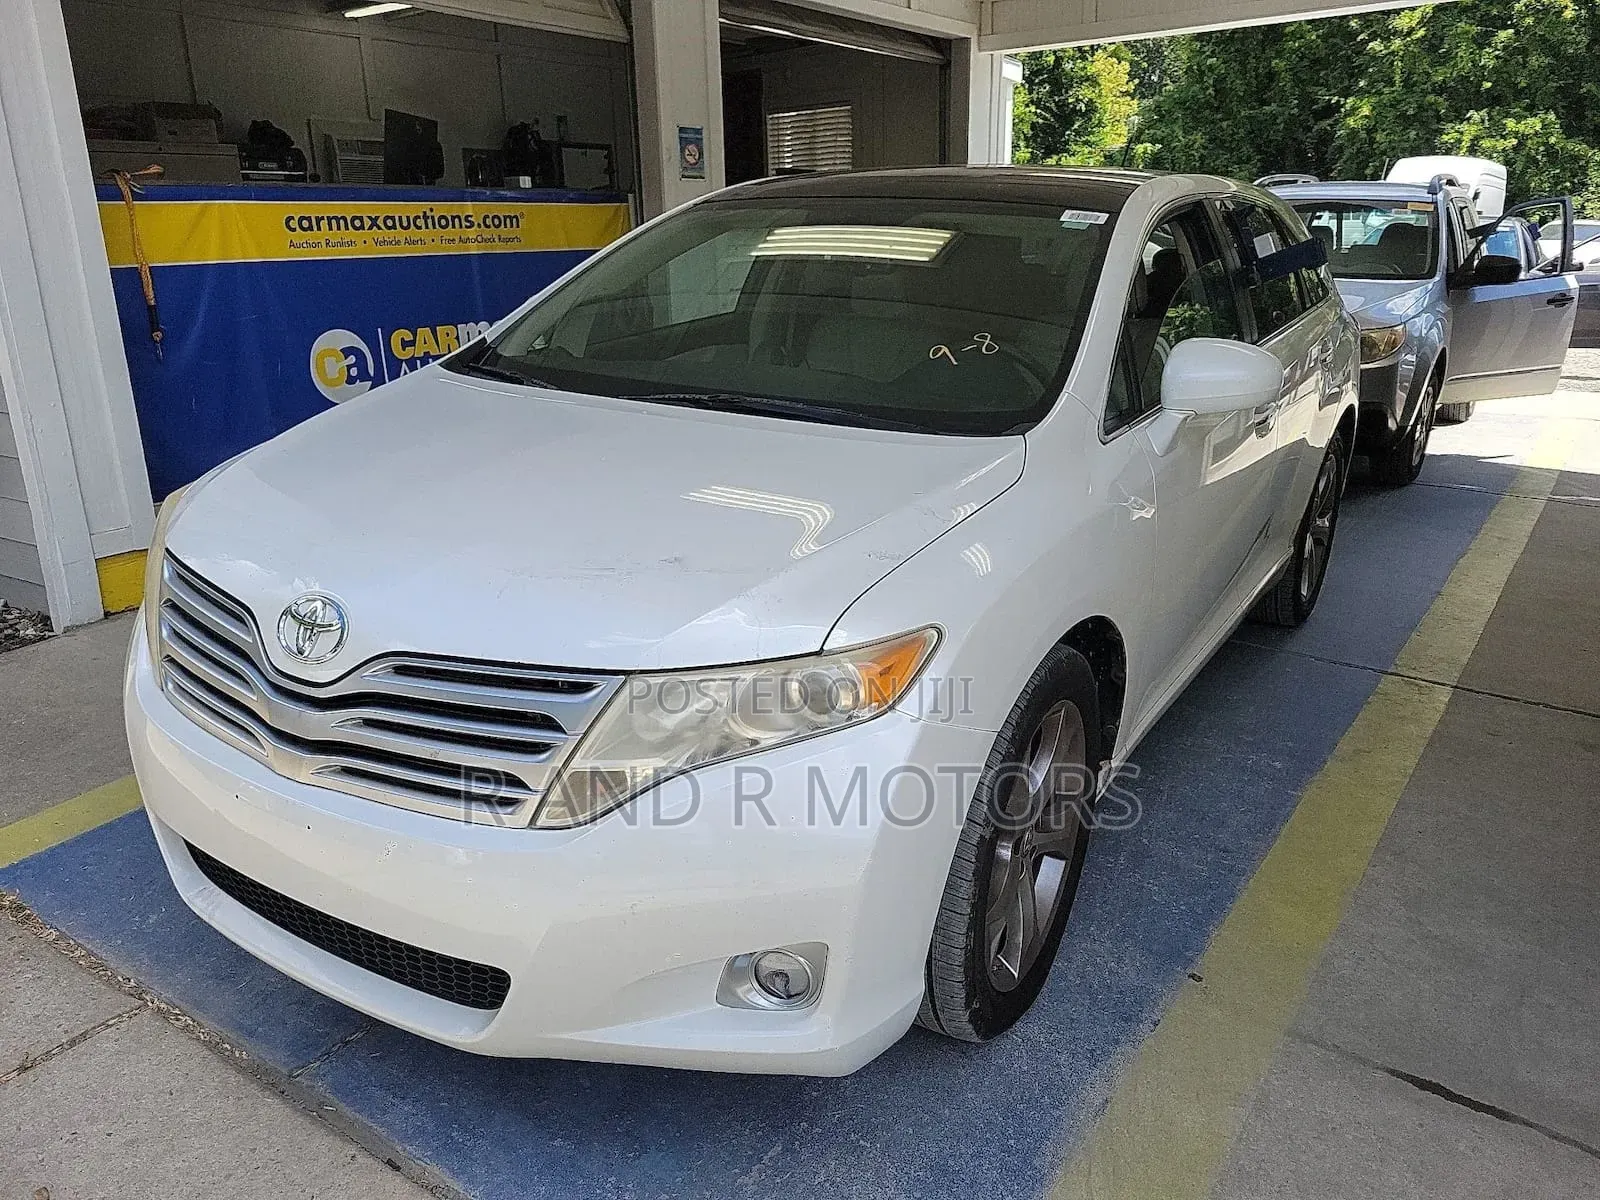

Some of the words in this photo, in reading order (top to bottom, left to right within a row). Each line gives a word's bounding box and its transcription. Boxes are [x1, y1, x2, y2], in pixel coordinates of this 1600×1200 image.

[289, 239, 322, 249] Auction
[325, 237, 357, 248] Runlists
[373, 235, 401, 247] Vehicle
[404, 236, 426, 246] Alerts
[440, 235, 456, 245] Free
[459, 233, 496, 244] AutoCheck
[498, 233, 522, 245] Reports
[391, 321, 500, 360] CARm
